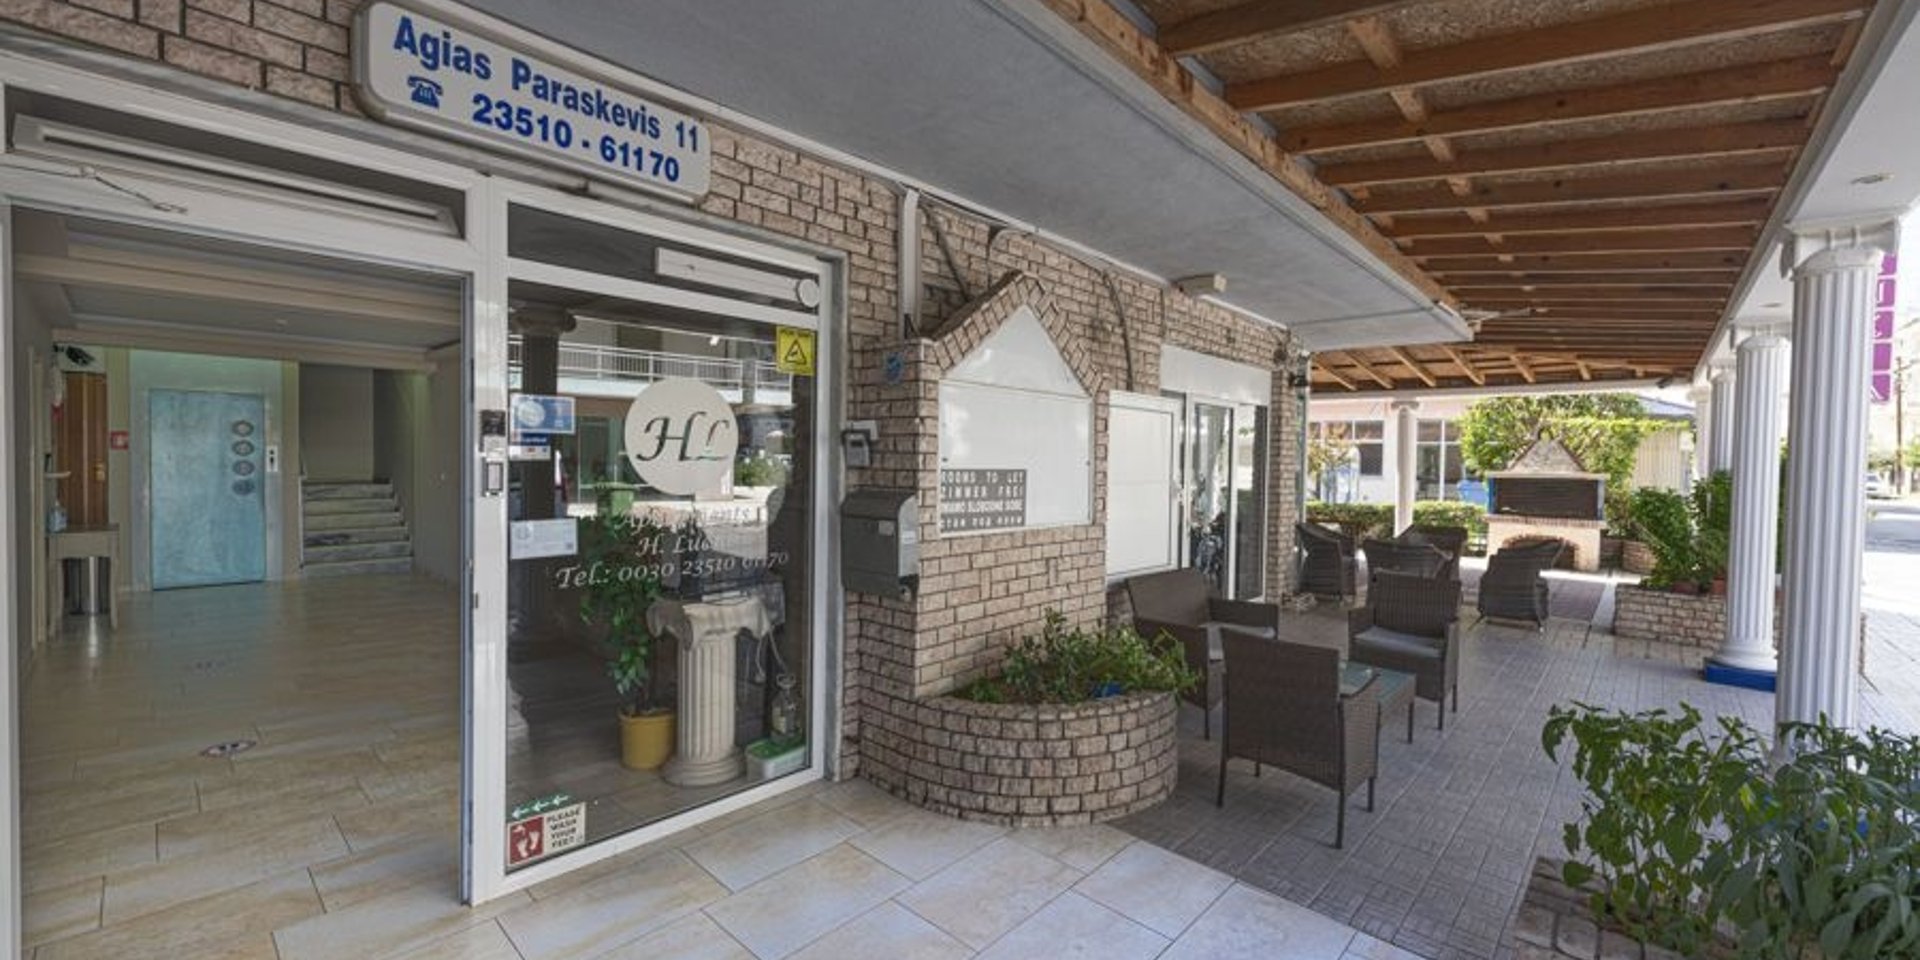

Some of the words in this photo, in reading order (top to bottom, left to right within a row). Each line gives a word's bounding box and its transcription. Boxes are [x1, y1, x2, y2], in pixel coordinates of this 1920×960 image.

[393, 15, 492, 80] Agias
[511, 57, 660, 139] Paraskevis
[675, 121, 698, 151] 11
[472, 93, 572, 148] 23510
[600, 136, 680, 182] 61170
[986, 471, 998, 483] TO
[617, 561, 676, 582] 0030
[681, 556, 736, 577] 23510
